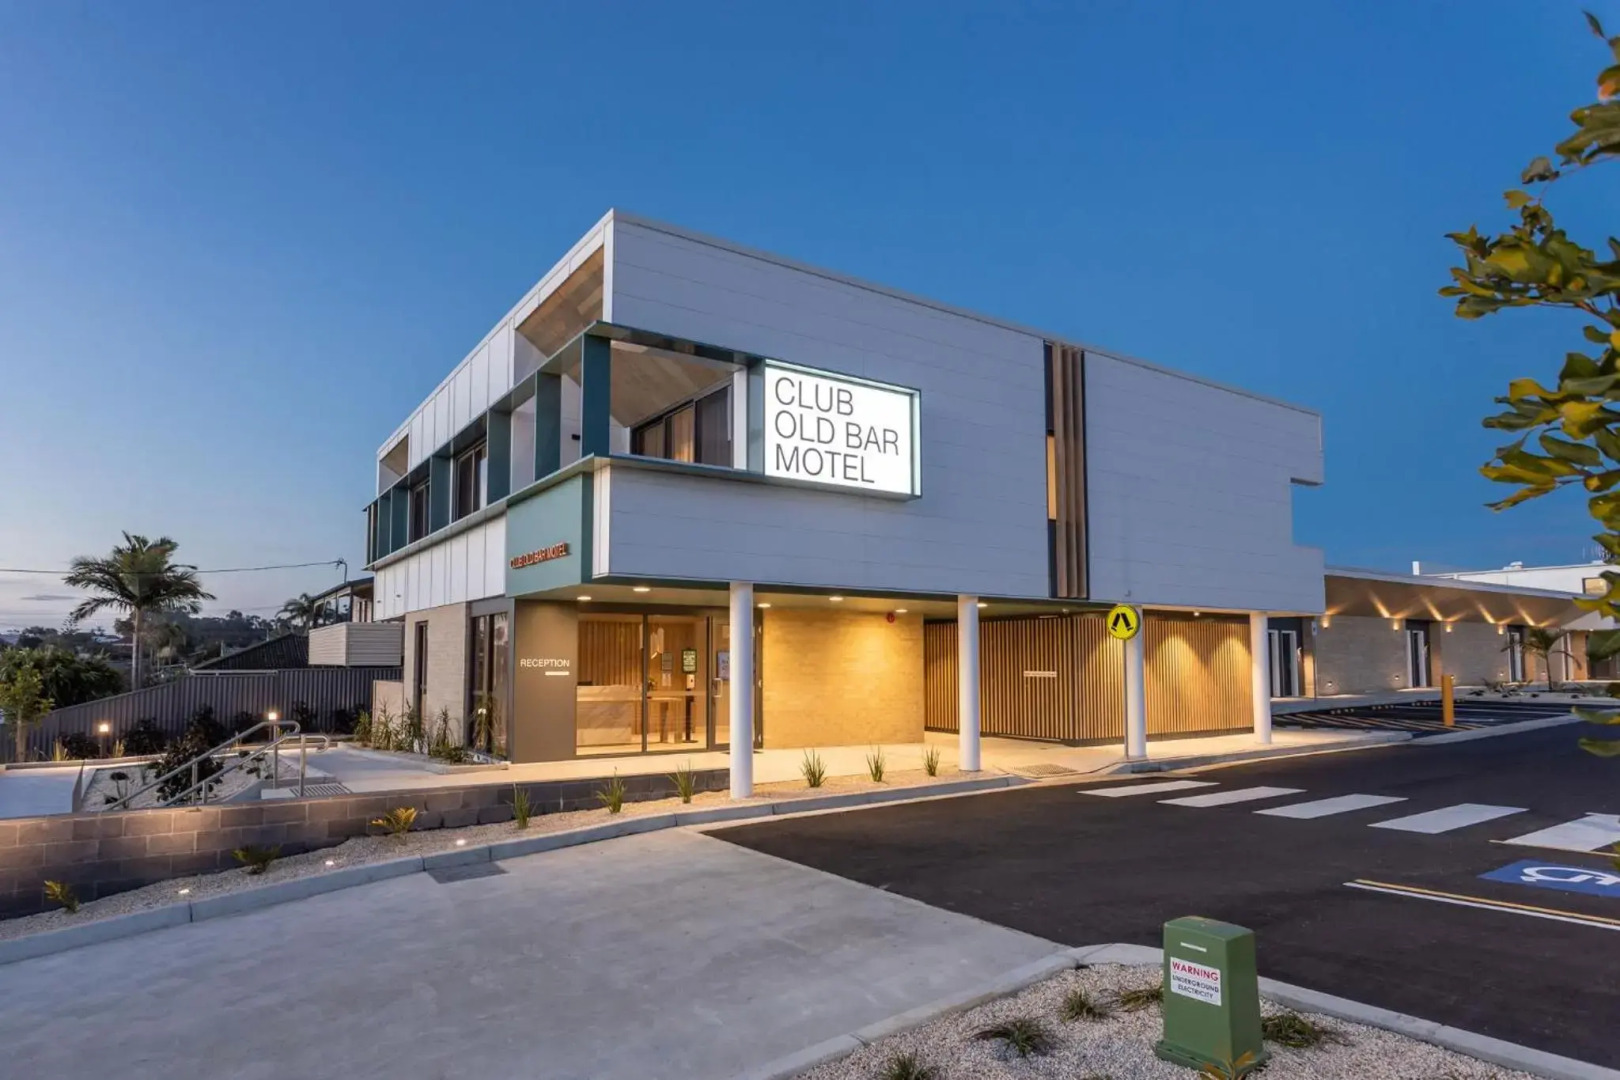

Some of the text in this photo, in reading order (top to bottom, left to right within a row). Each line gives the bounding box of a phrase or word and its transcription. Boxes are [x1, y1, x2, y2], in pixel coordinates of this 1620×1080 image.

[775, 377, 854, 416] CLUB
[775, 410, 899, 456] OLD BAR
[775, 443, 875, 483] MOTEL
[534, 548, 546, 562] BAR
[546, 542, 568, 560] MOTEL
[520, 658, 570, 668] RECEPTION
[1172, 961, 1219, 982] WARNING
[1172, 974, 1219, 993] UNDERGROUND
[1178, 984, 1214, 999] ELECTRICITY
